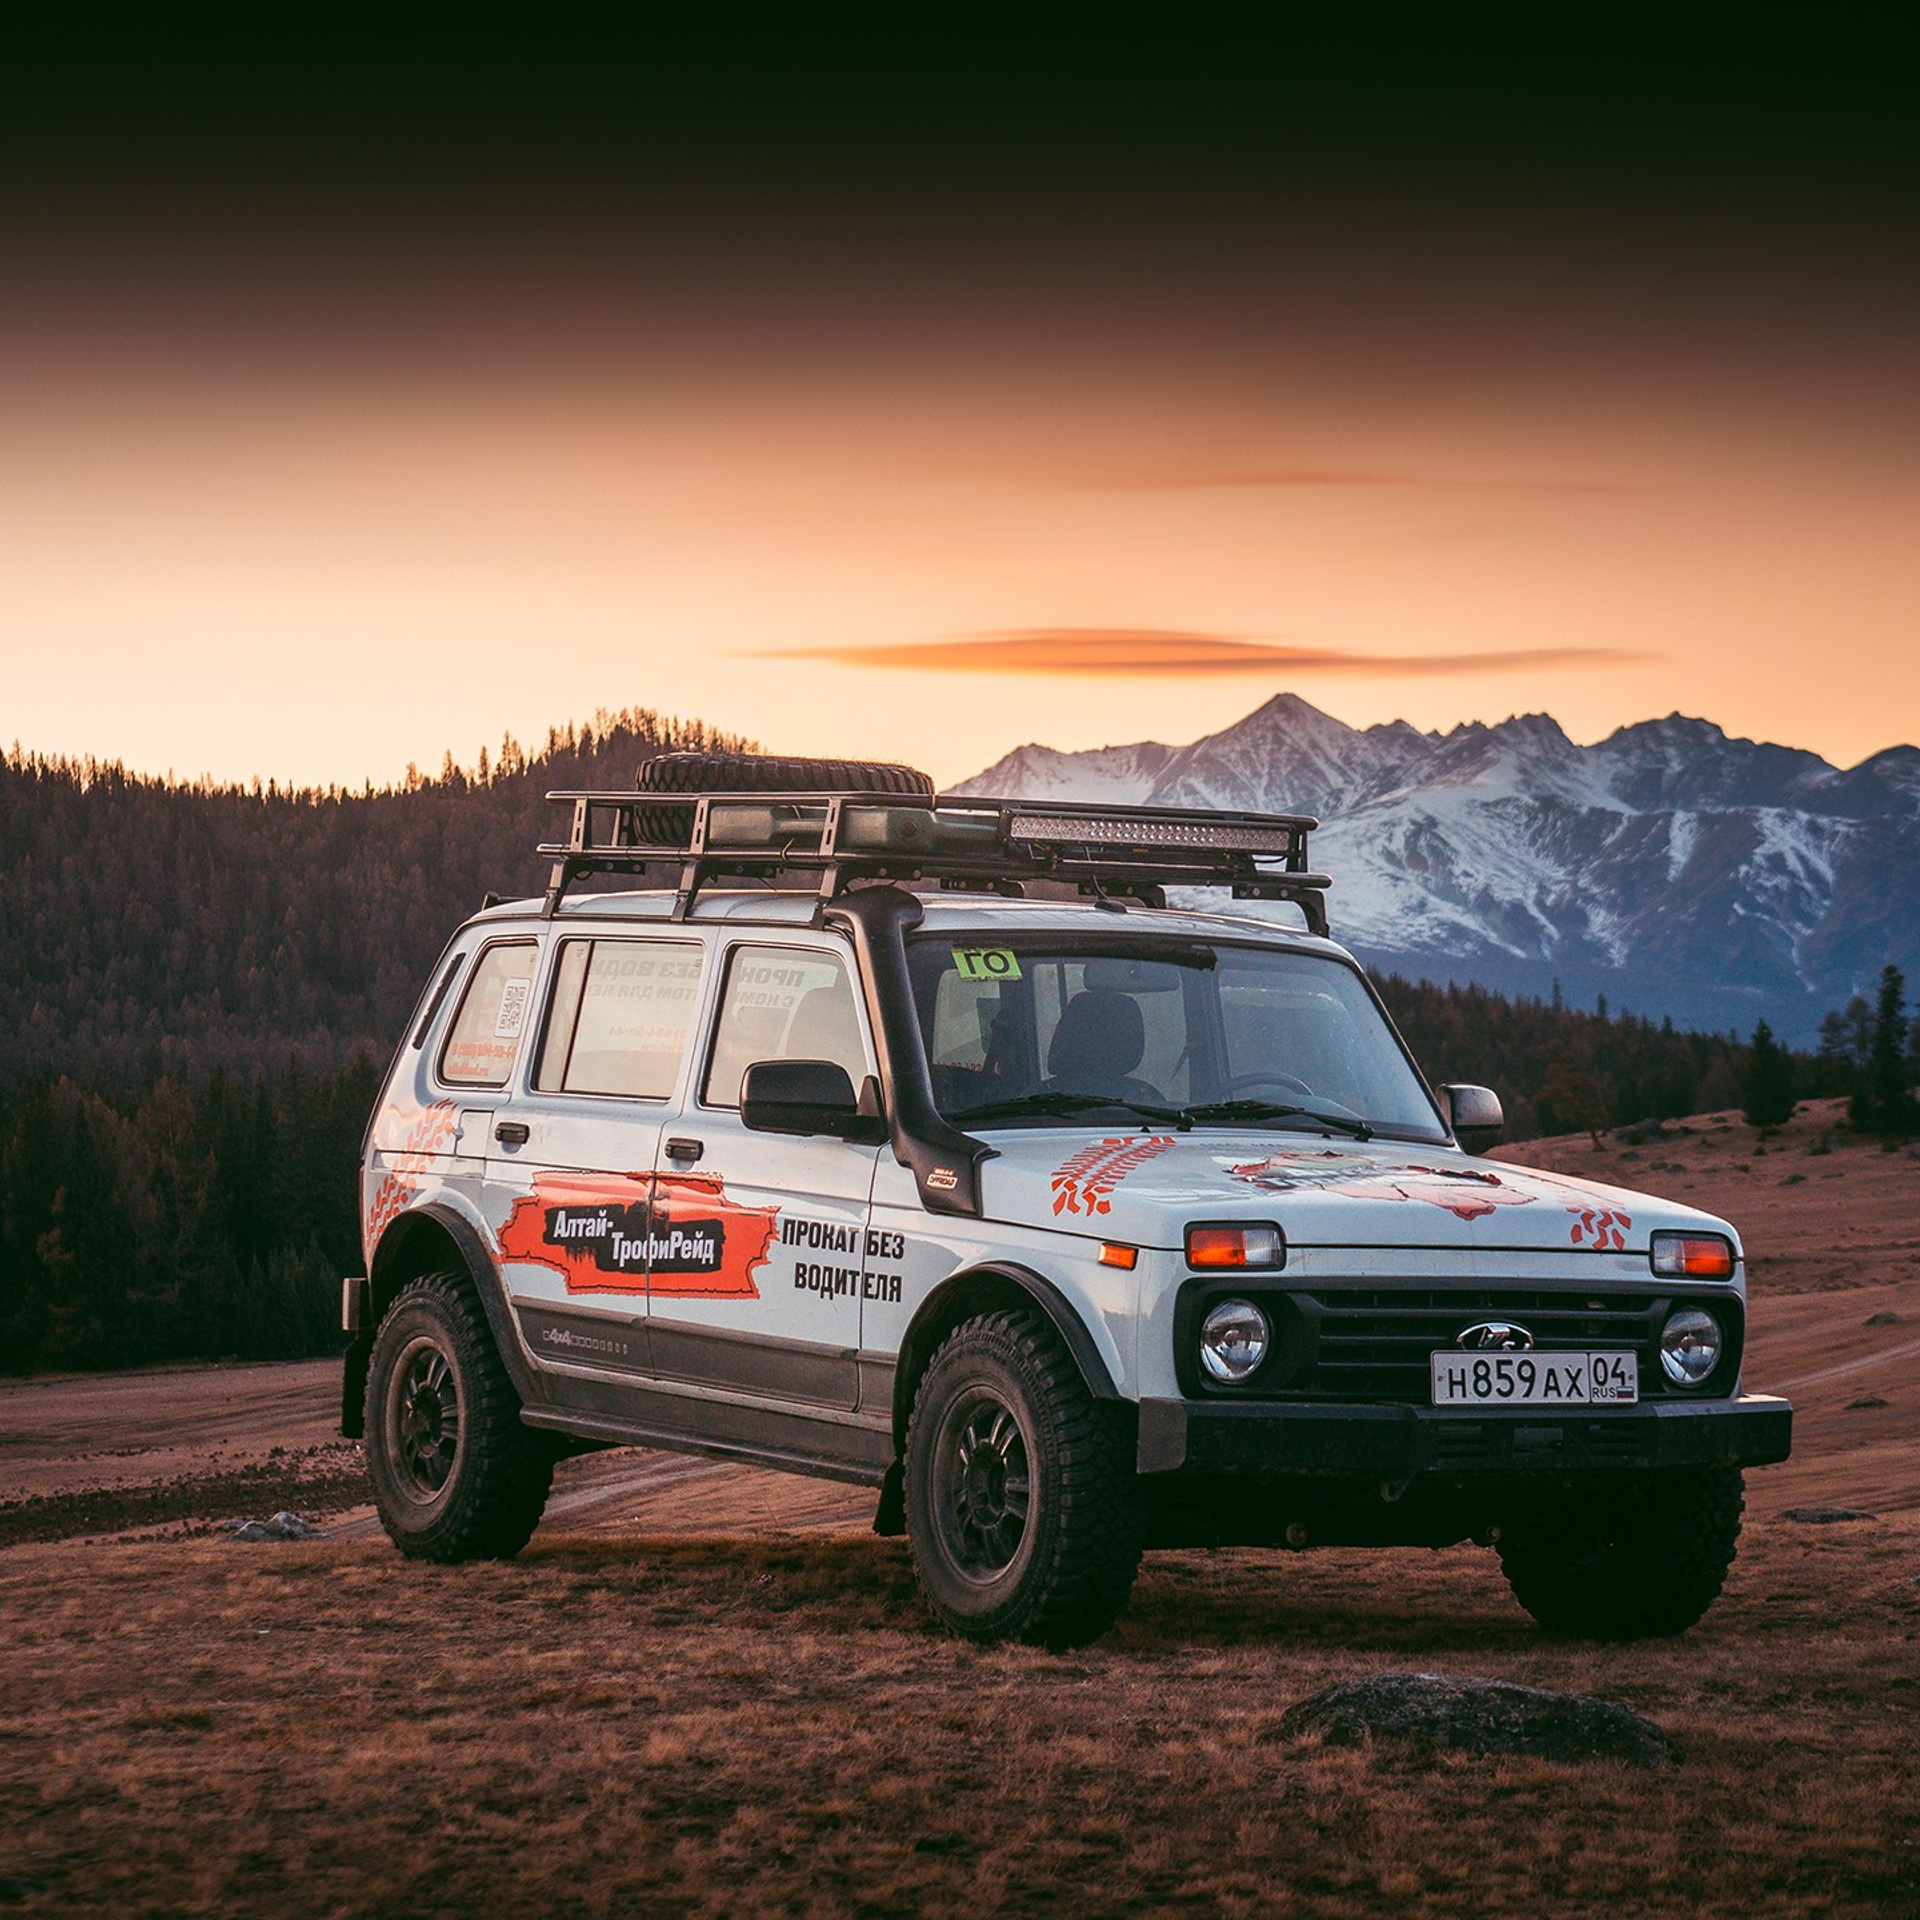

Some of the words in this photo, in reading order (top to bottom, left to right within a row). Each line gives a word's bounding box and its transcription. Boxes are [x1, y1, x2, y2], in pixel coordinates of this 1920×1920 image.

[553, 1209, 615, 1239] Алтай-
[781, 1218, 860, 1254] ПРОКАТ
[866, 1229, 906, 1260] БЕЗ
[611, 1230, 715, 1268] ТрофиРейд
[794, 1262, 903, 1303] ВОДИТЕЛЯ
[1592, 1356, 1627, 1387] 04
[1591, 1386, 1617, 1398] RUS
